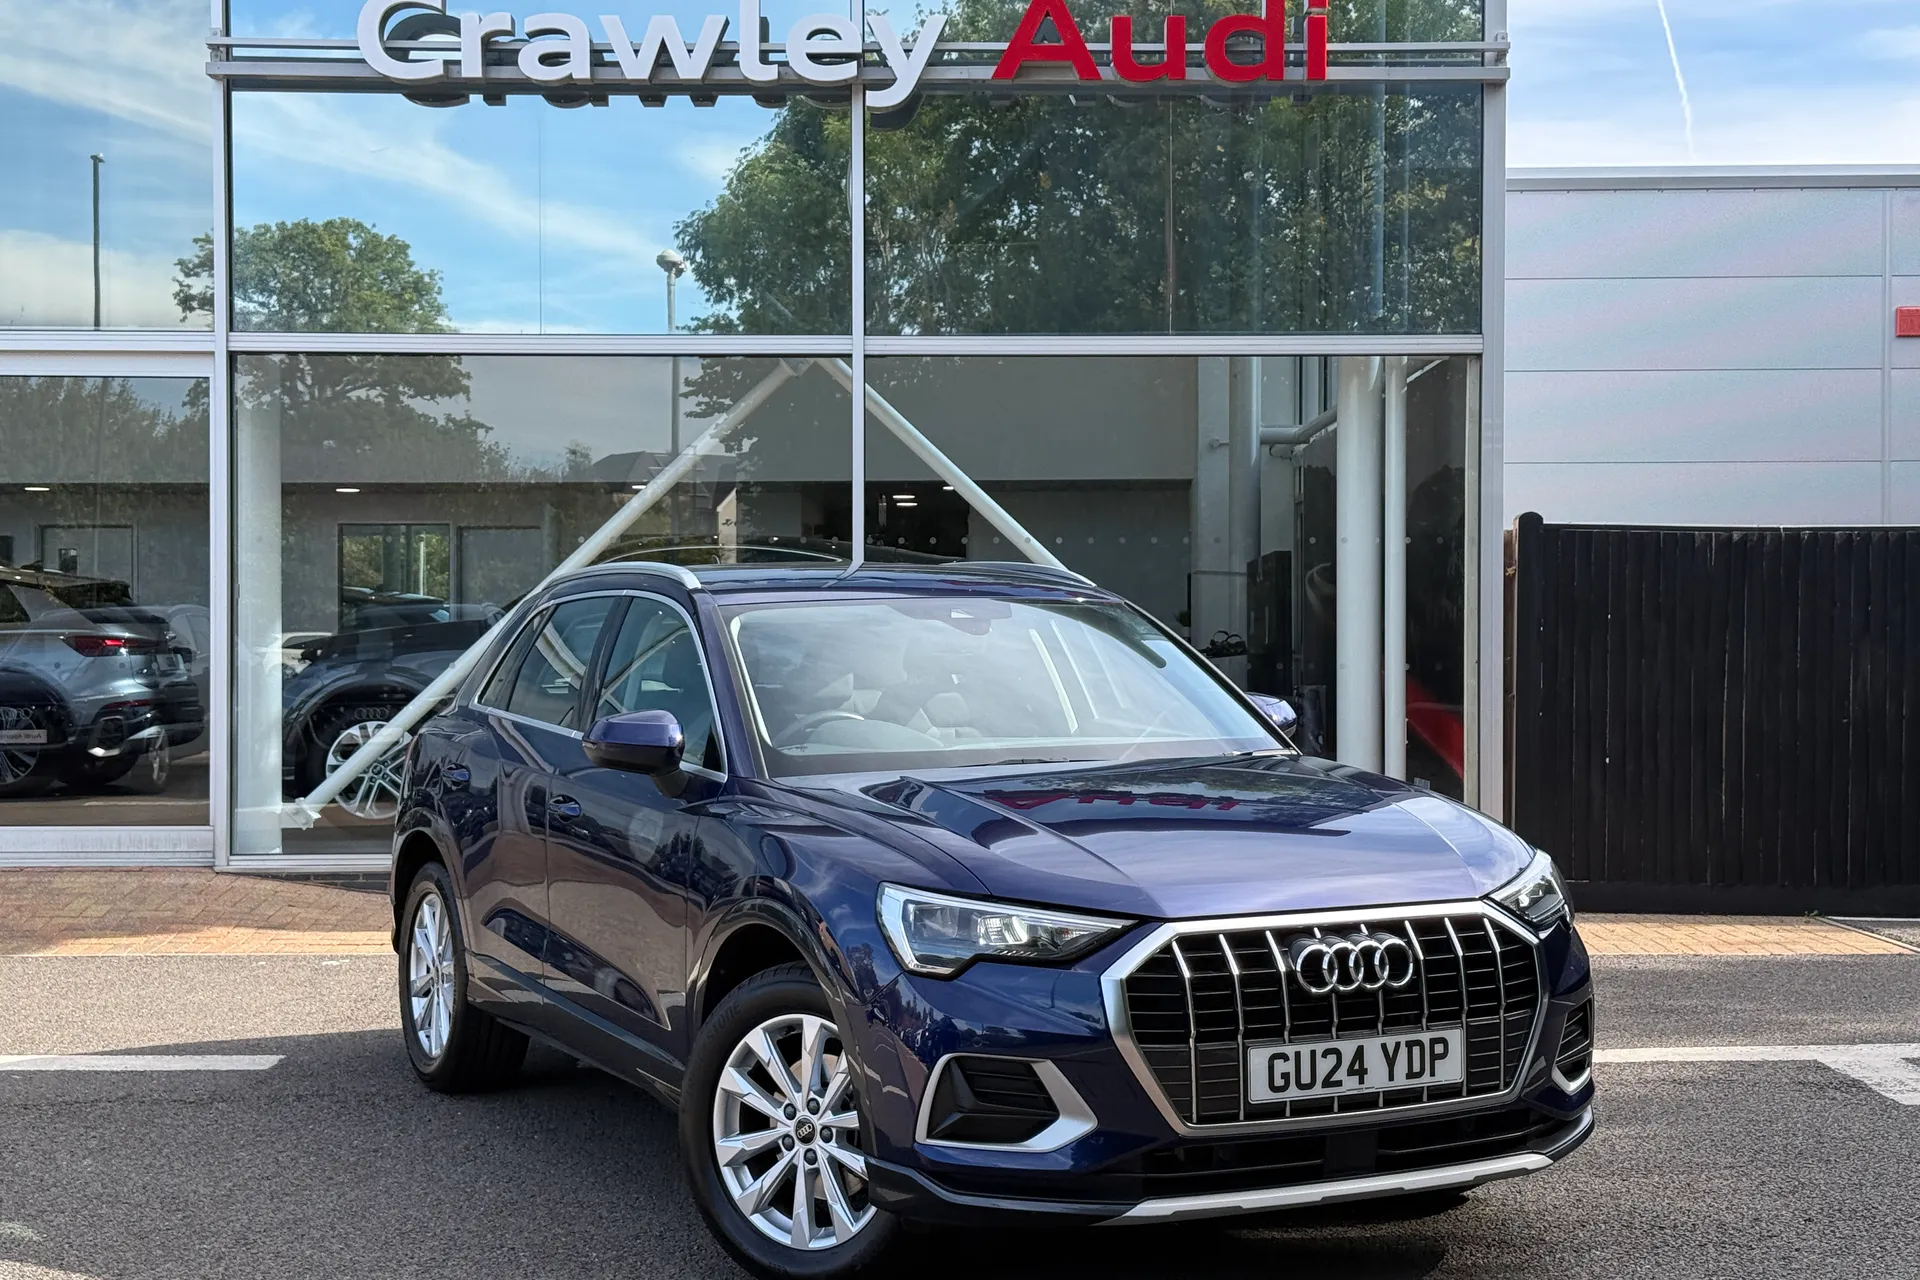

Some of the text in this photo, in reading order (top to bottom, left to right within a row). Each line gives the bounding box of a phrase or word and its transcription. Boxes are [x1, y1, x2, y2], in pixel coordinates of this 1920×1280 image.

[357, 0, 1328, 107] Crawley Audi
[1268, 1037, 1449, 1093] GU24 YDP
